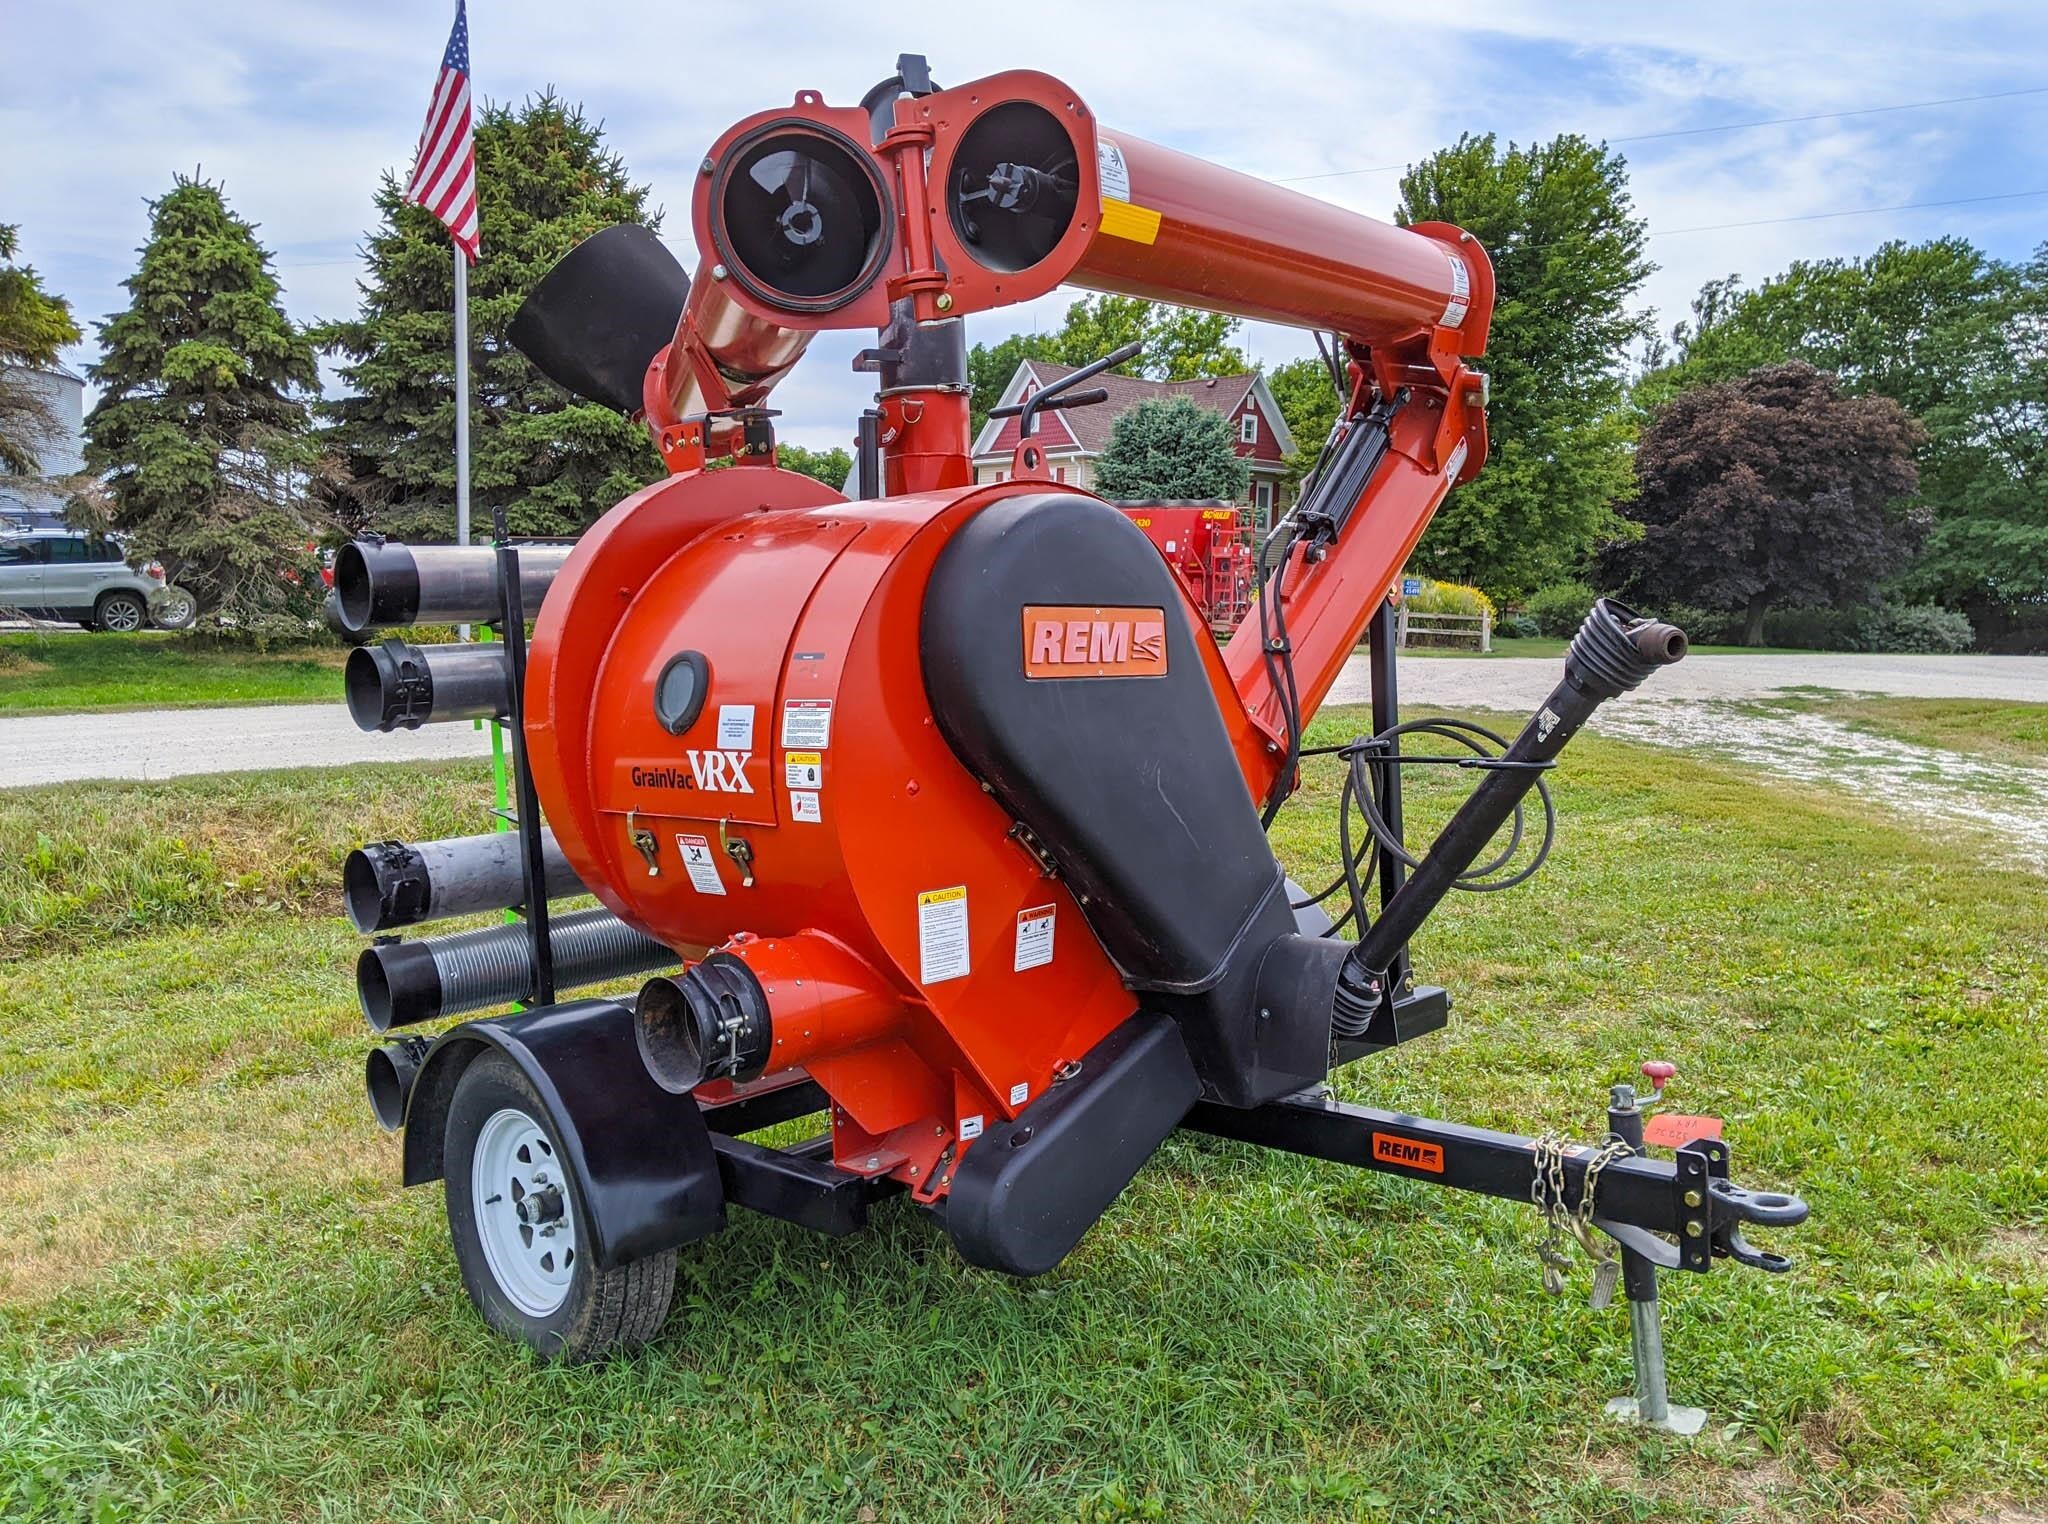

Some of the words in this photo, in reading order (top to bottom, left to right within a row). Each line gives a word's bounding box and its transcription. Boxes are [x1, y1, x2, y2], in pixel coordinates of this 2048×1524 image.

[1031, 621, 1130, 664] REM
[632, 766, 694, 790] GrainVac
[685, 749, 755, 794] VRX
[932, 891, 962, 902] CAUTION
[1029, 907, 1054, 918] WARNING
[1378, 1140, 1421, 1162] REM
